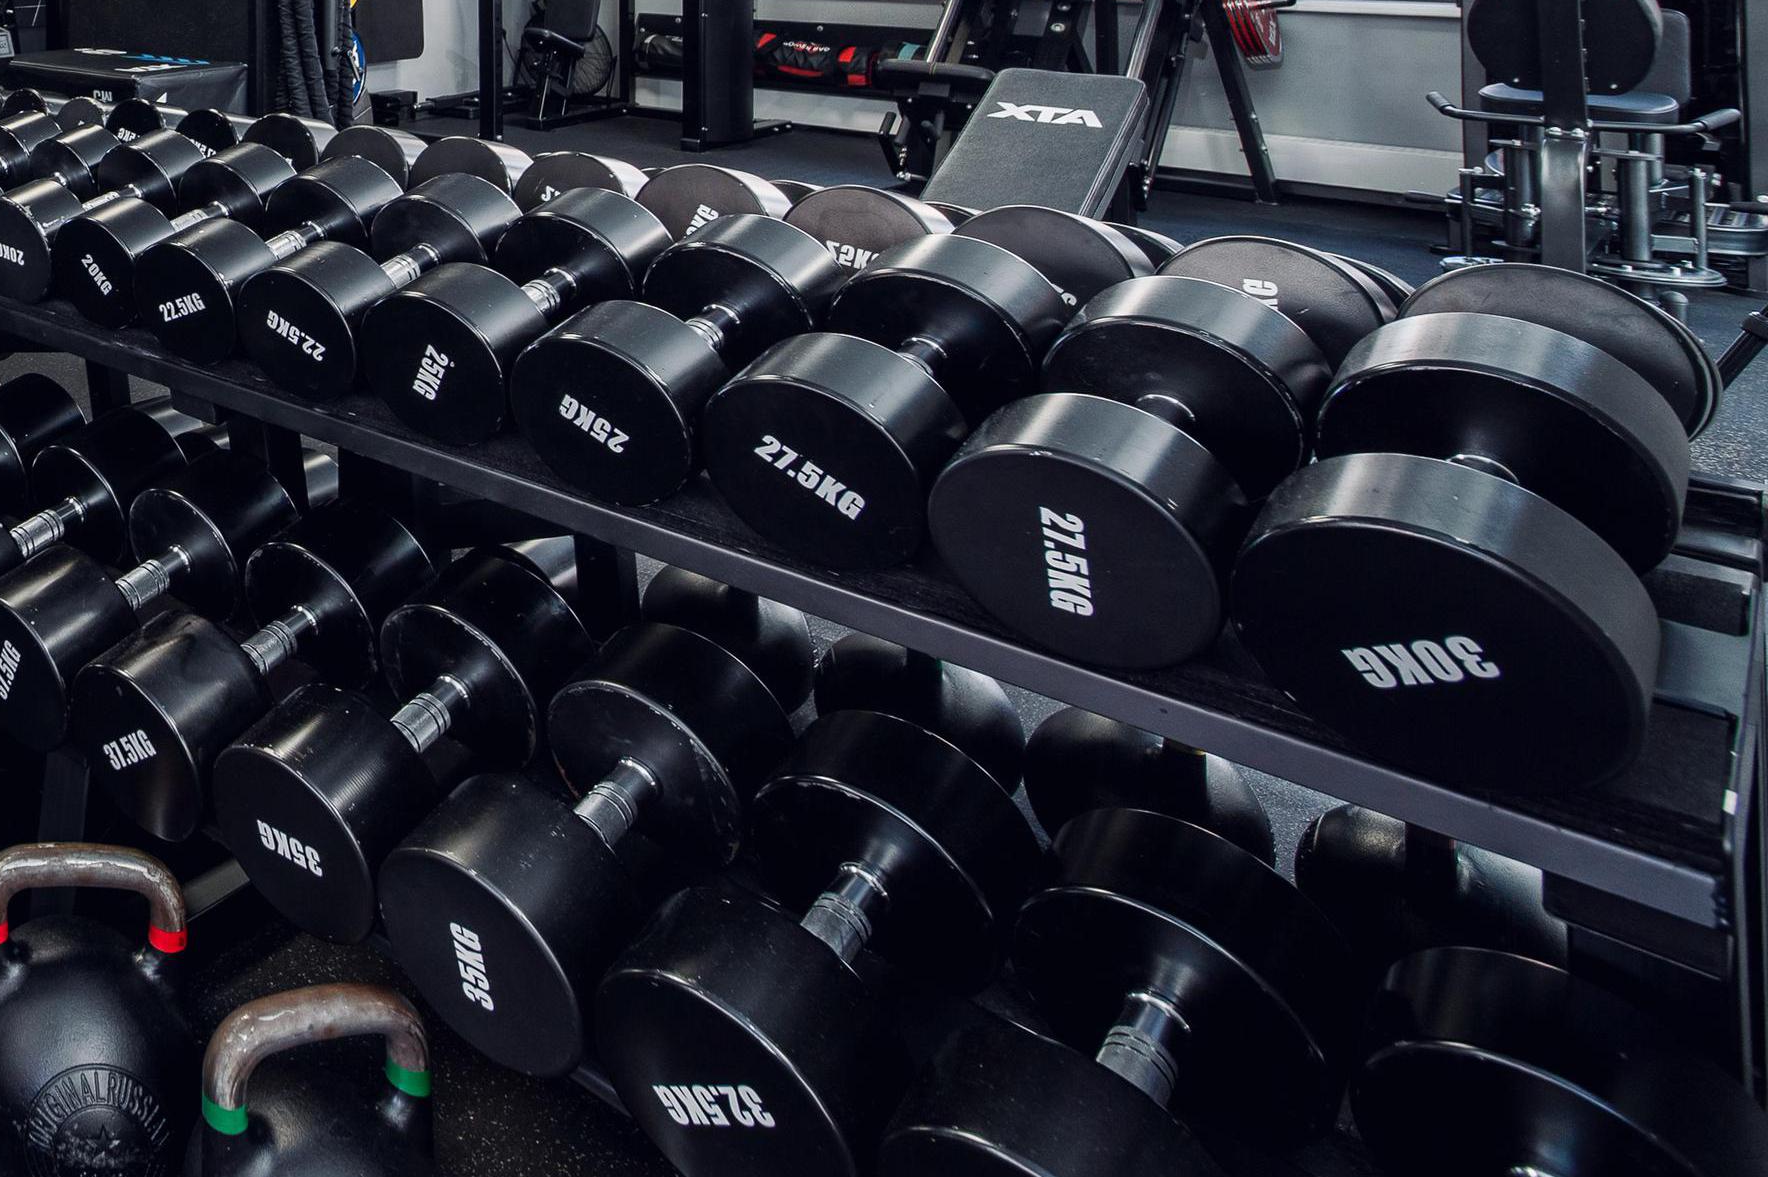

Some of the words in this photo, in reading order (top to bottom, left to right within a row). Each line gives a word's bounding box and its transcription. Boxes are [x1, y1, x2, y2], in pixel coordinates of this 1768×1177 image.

[81, 254, 113, 296] 20KG
[158, 292, 206, 322] 22.5KG
[266, 310, 326, 362] 22.5KG
[411, 344, 448, 401] 25KG
[558, 393, 630, 454] 25KG
[753, 434, 866, 521] 27.5KG
[1039, 506, 1094, 617] 27.5KG
[1341, 635, 1501, 689] 30KG
[103, 728, 157, 771] 37.5KG
[256, 818, 324, 878] 35KG
[449, 922, 495, 1012] 35KG
[652, 1084, 776, 1128] 32.5KG
